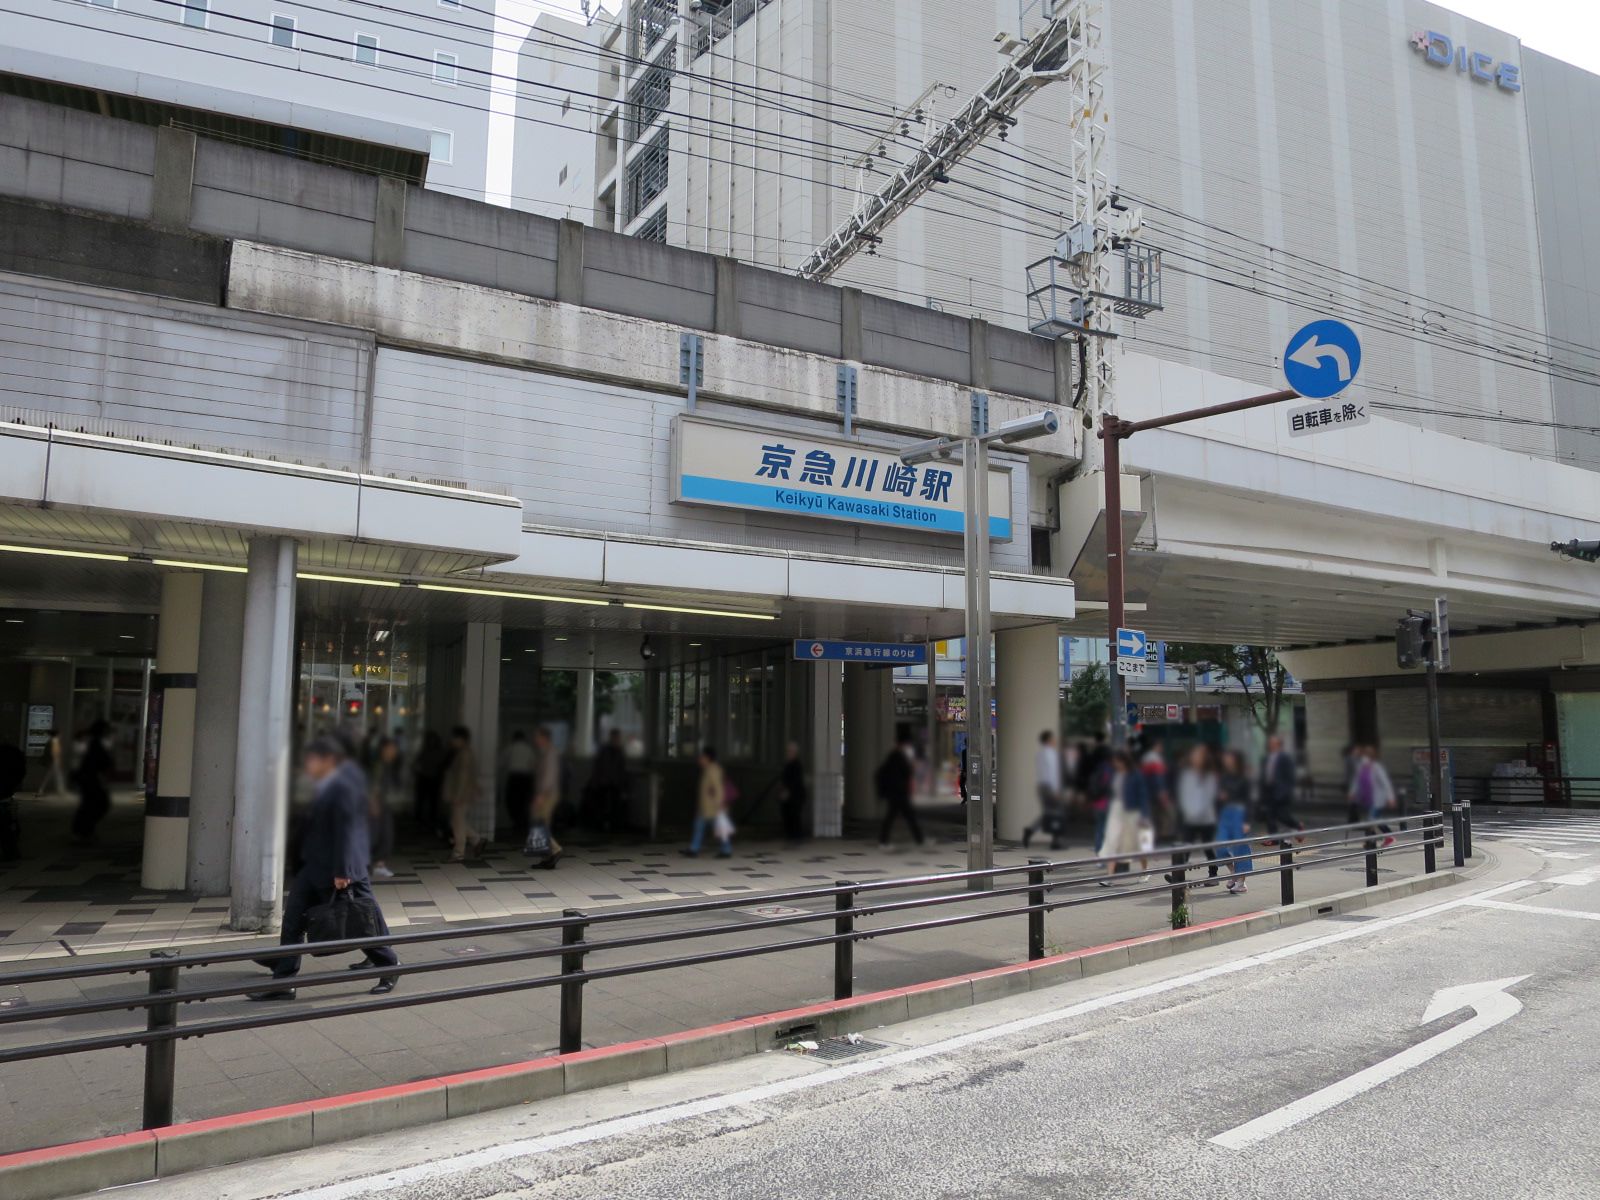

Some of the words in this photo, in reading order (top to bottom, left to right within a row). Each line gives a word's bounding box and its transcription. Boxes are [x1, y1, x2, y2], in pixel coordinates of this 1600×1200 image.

[1427, 31, 1521, 92] DICE
[1292, 403, 1366, 431] 自転車を除く
[755, 443, 953, 503] 京急川崎駅
[775, 489, 823, 509] Keikyū
[827, 496, 890, 518] Kawasaki
[892, 506, 937, 523] Station
[1119, 661, 1145, 674] ここまで
